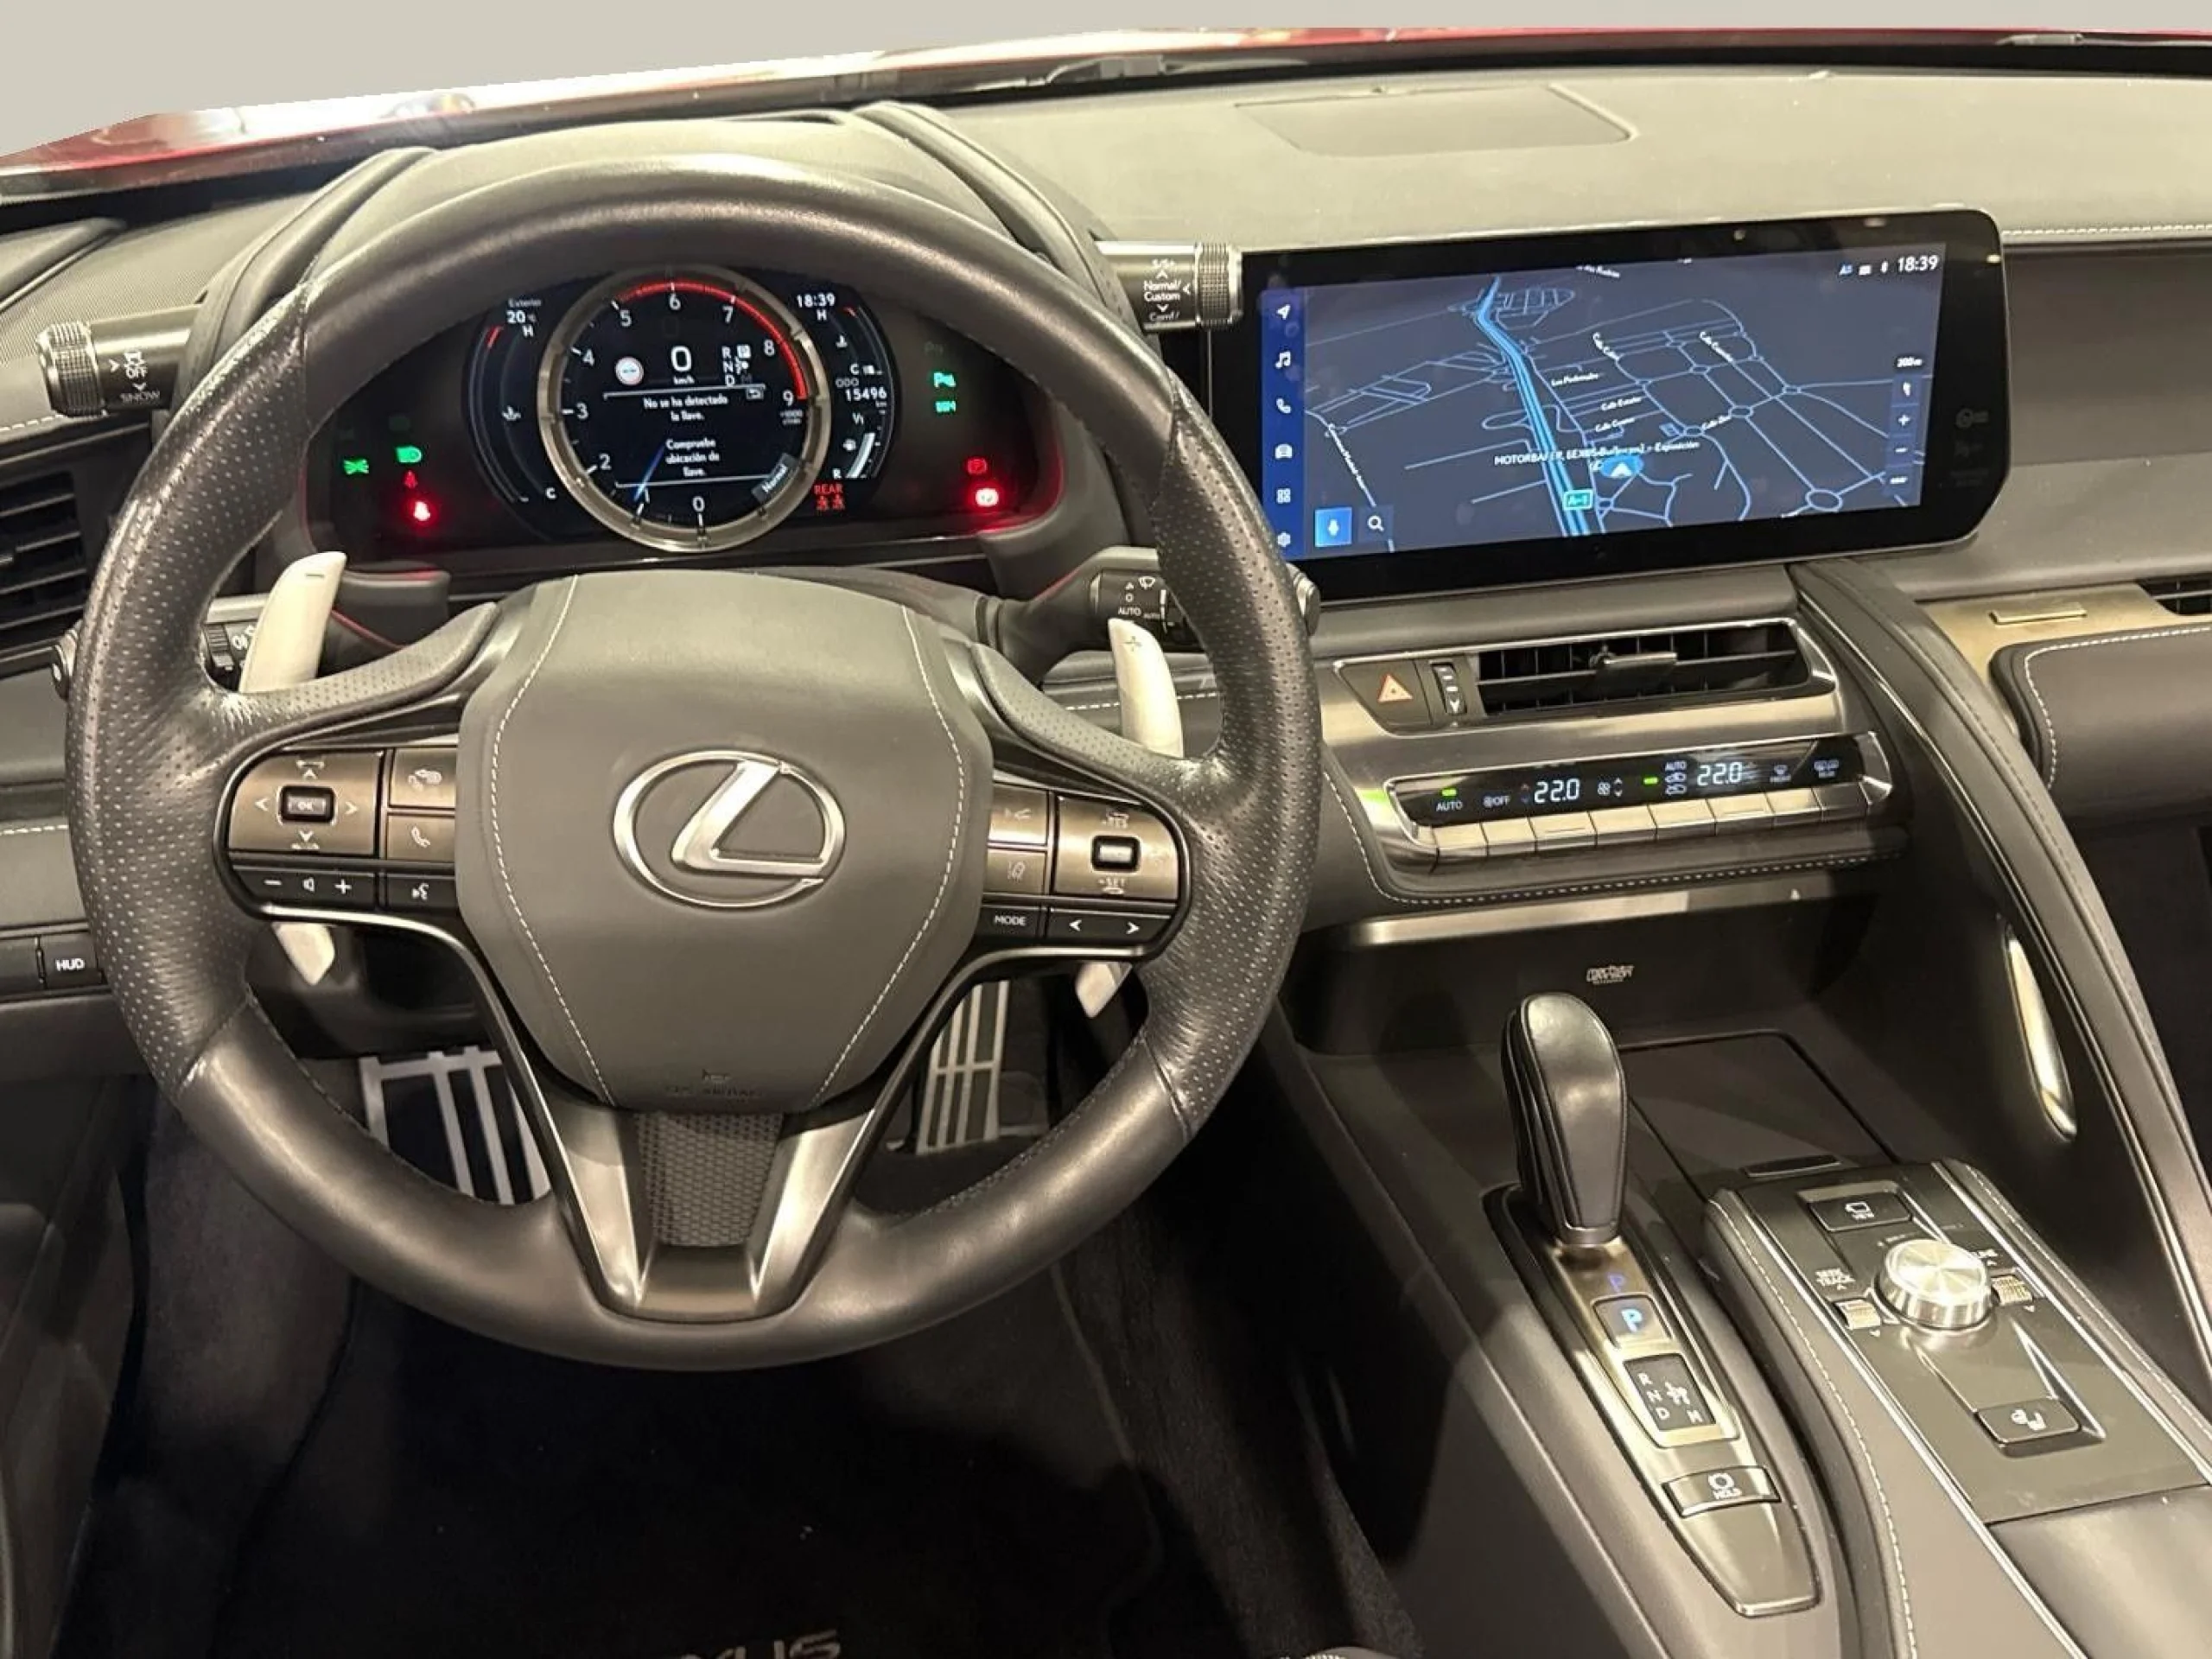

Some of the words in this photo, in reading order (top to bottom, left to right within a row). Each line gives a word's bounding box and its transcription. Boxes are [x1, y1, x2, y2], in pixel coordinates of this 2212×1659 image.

[1897, 255, 1939, 271] 18:39
[669, 294, 681, 310] 6
[797, 293, 836, 308] 18:39
[1144, 291, 1180, 302] Custom
[505, 310, 526, 324] 20
[620, 309, 632, 327] 5
[722, 307, 734, 323] 7
[817, 309, 827, 321] H
[522, 325, 534, 338] H
[721, 346, 732, 359] R
[764, 340, 775, 356] 8
[582, 349, 594, 366] 4
[671, 346, 692, 372] 0
[126, 367, 148, 378] OFF
[722, 360, 734, 372] N
[849, 364, 859, 375] C
[725, 374, 735, 387] D
[783, 390, 793, 406] 9
[845, 386, 887, 401] 15496
[643, 397, 658, 409] No
[671, 397, 683, 407] ha
[684, 393, 728, 406] detectado
[577, 403, 588, 419] 3
[671, 410, 680, 422] la
[665, 437, 716, 450] Compruebe
[599, 454, 612, 470] 2
[708, 451, 720, 461] de
[545, 486, 556, 499] C
[814, 483, 843, 494] REAR
[693, 497, 704, 512] 0
[1118, 607, 1141, 616] AUTO
[1697, 761, 1743, 786] 22.0
[1535, 778, 1580, 804] 22.0
[298, 802, 313, 810] OK
[1436, 801, 1463, 811] AUTO
[1492, 795, 1511, 806] OFF
[995, 914, 1027, 926] MODE
[55, 957, 85, 971] HUD
[1621, 1308, 1642, 1332] P
[1638, 1372, 1653, 1385] R
[1647, 1389, 1662, 1402] N
[1656, 1407, 1670, 1420] D
[1687, 1409, 1704, 1424] M
[1713, 1488, 1742, 1500] HOLD
